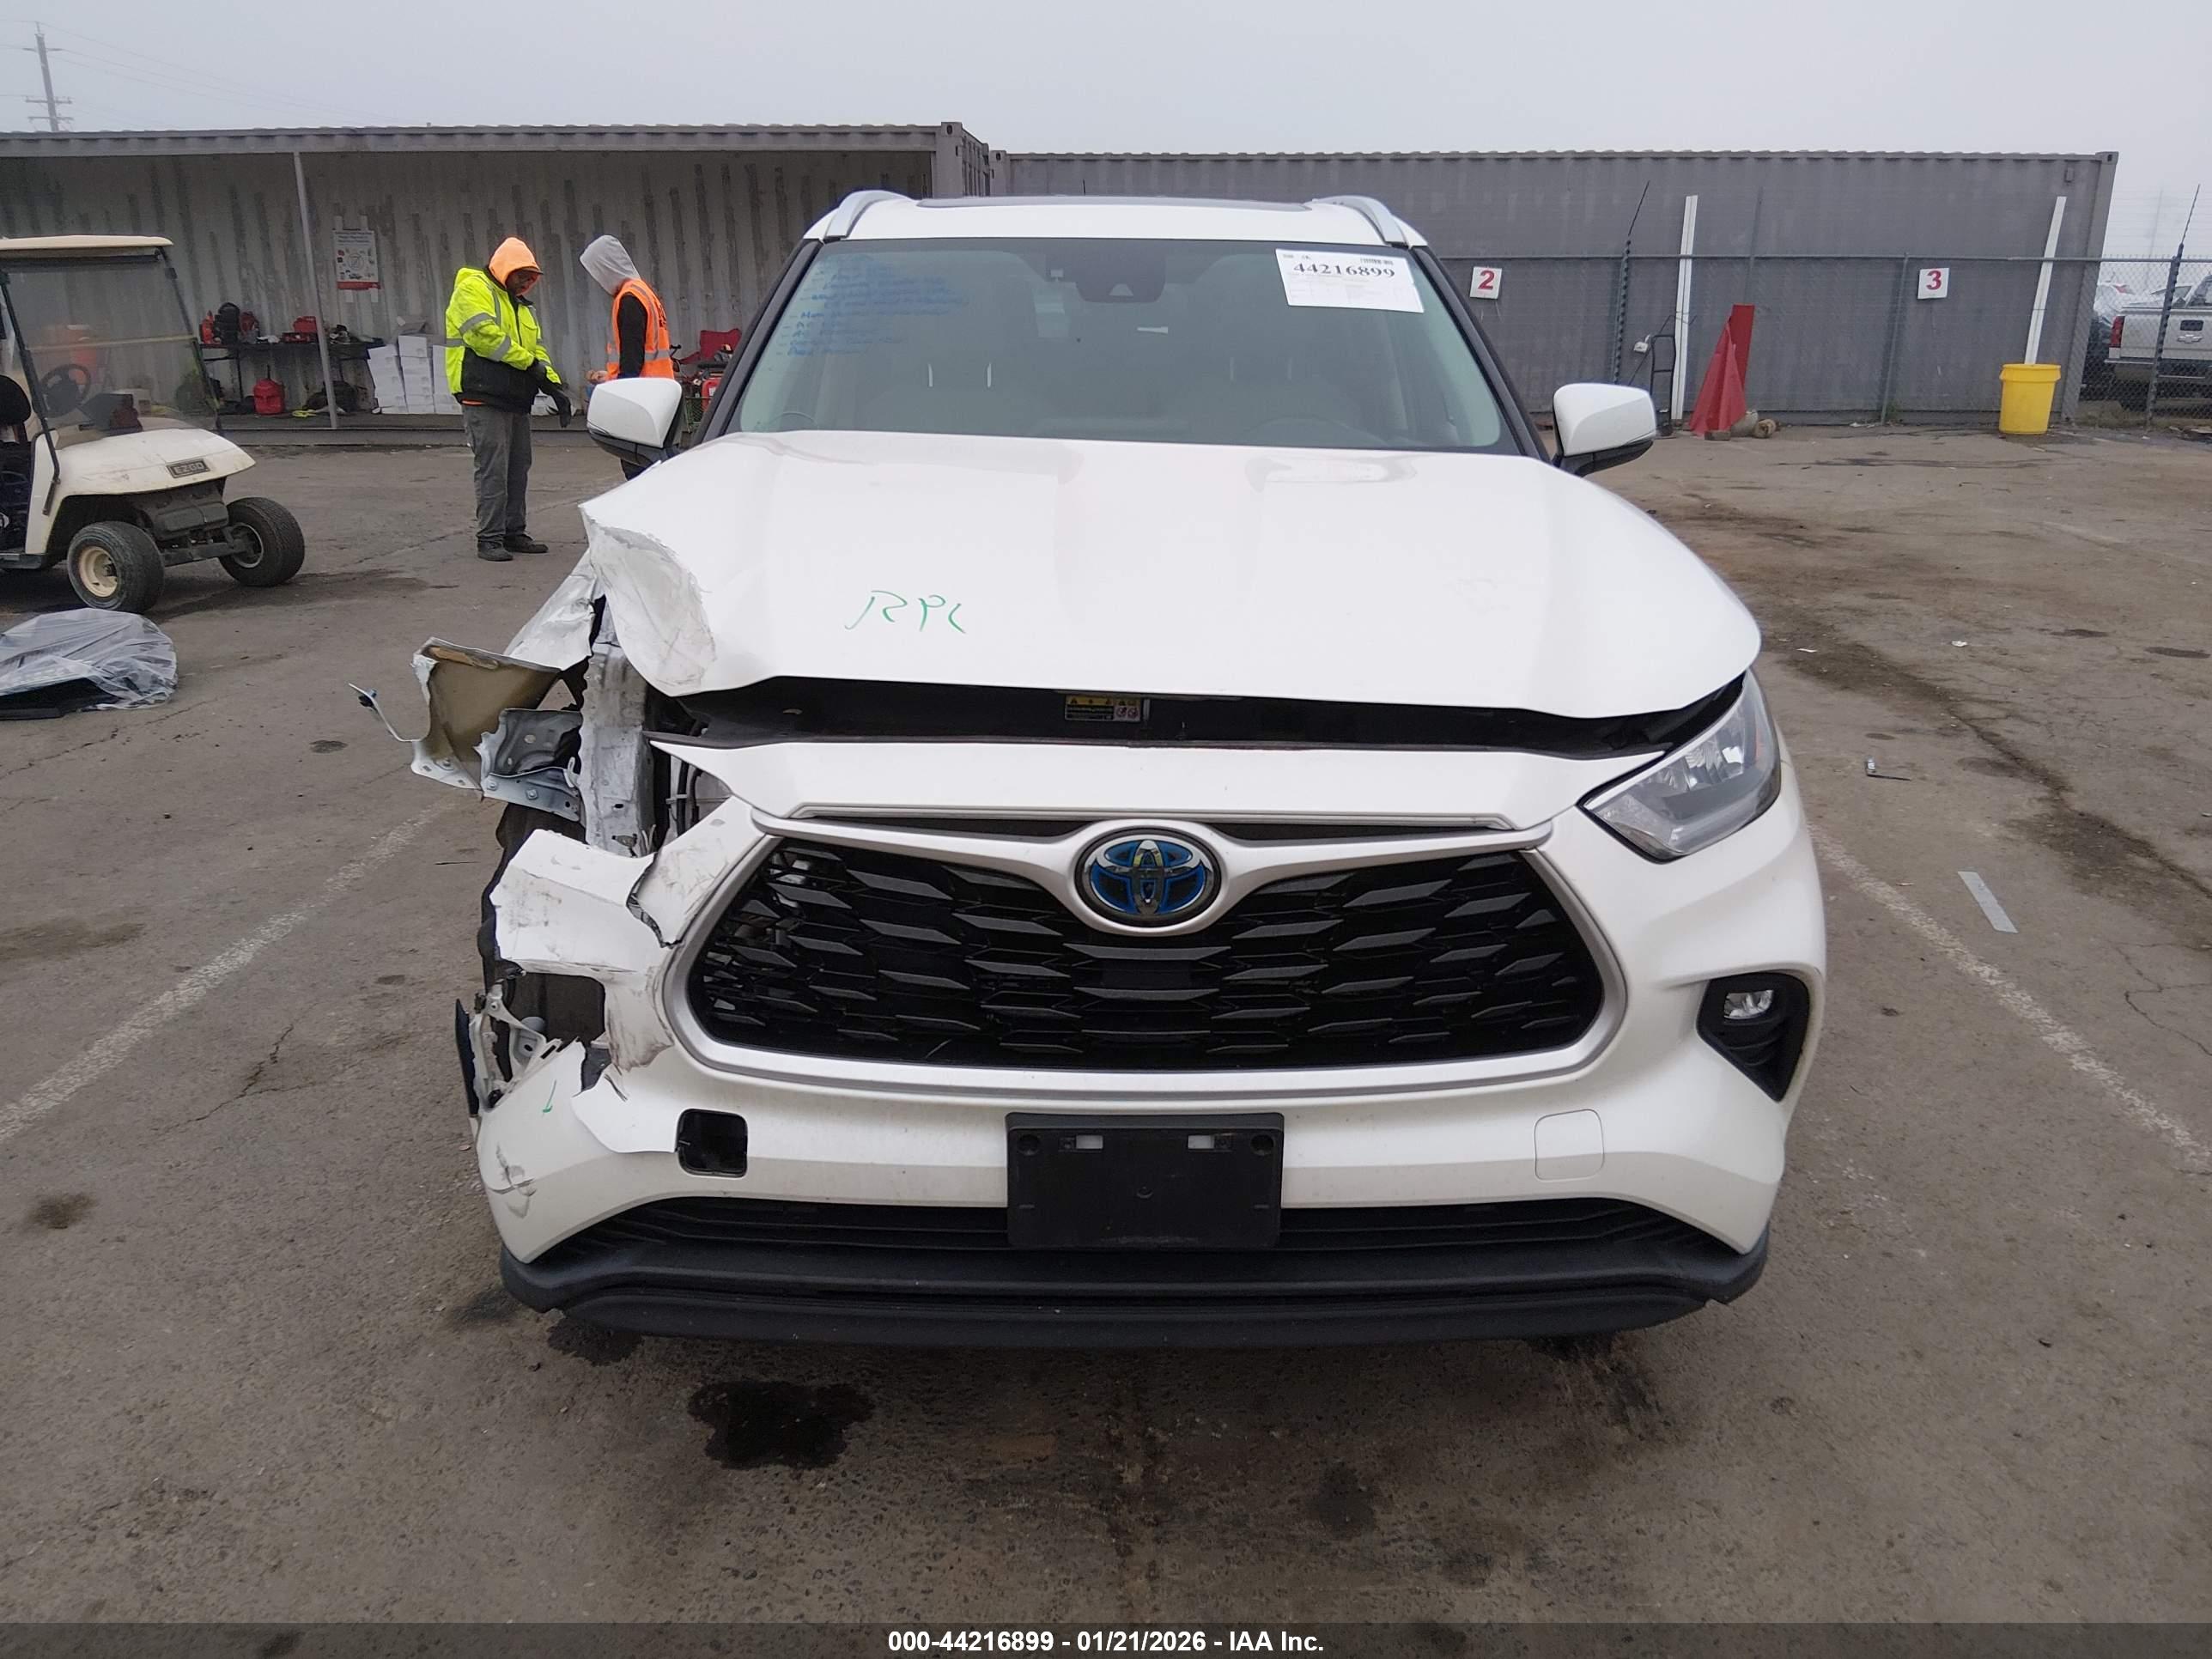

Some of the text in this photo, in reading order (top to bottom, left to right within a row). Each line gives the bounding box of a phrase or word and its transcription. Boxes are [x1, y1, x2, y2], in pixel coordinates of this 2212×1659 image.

[1293, 262, 1395, 279] 44216899
[1478, 270, 1496, 290] 2
[1926, 270, 1942, 290] 3
